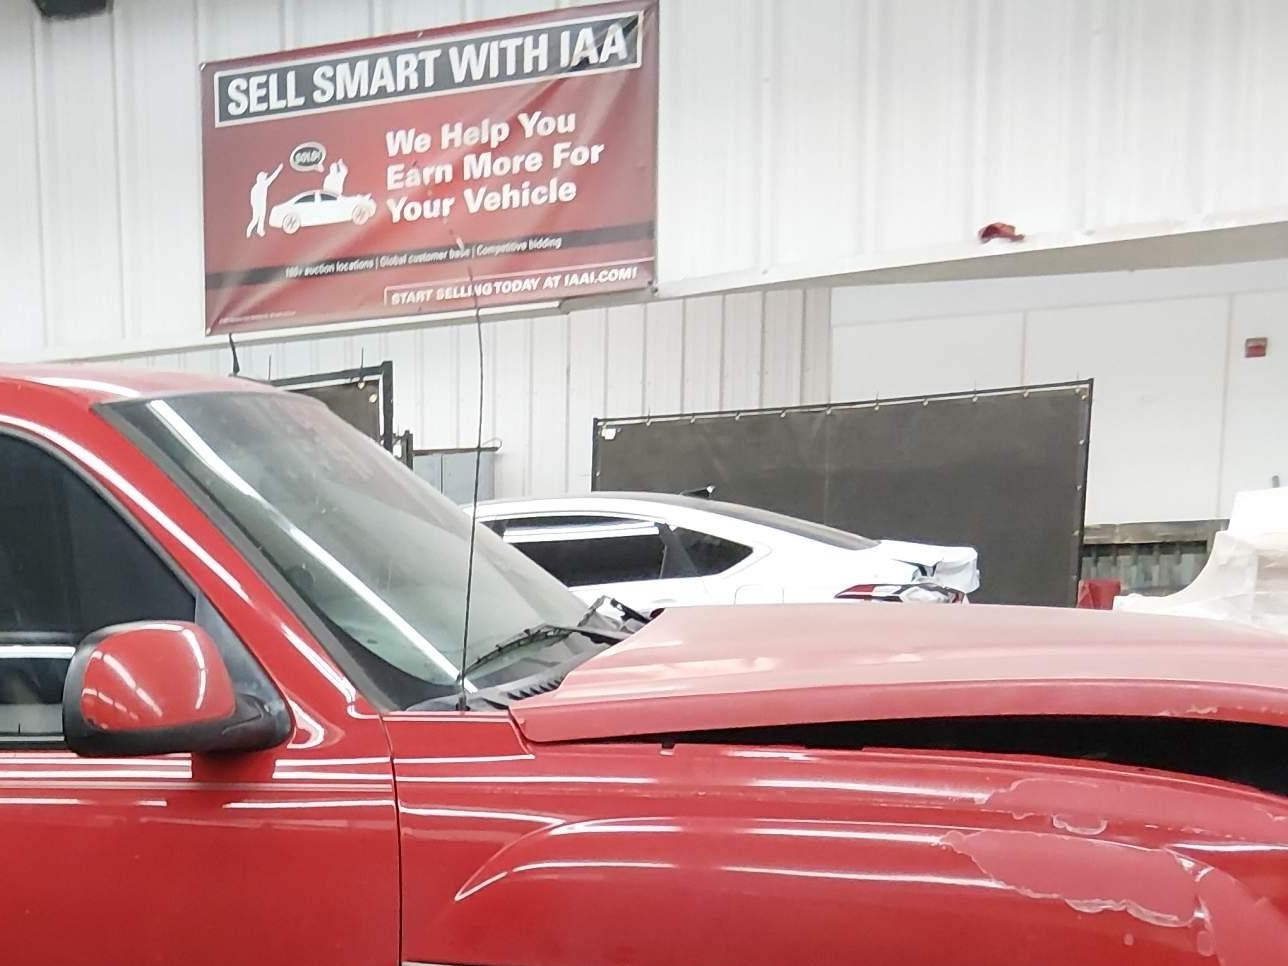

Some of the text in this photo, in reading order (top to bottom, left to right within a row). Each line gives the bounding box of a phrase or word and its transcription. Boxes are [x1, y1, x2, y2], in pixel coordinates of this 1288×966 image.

[227, 23, 630, 117] SELL SMART WITH IAA
[386, 111, 576, 157] We Help You
[386, 140, 606, 191] Earn More For
[387, 178, 577, 224] Your Vehicle
[335, 258, 374, 274] locations
[379, 253, 407, 267] Global
[408, 249, 448, 265] customer
[476, 240, 527, 257] Competitive
[528, 236, 562, 251] bidding
[391, 266, 638, 306] START SELLING TODAY AT IAAI.COM!
